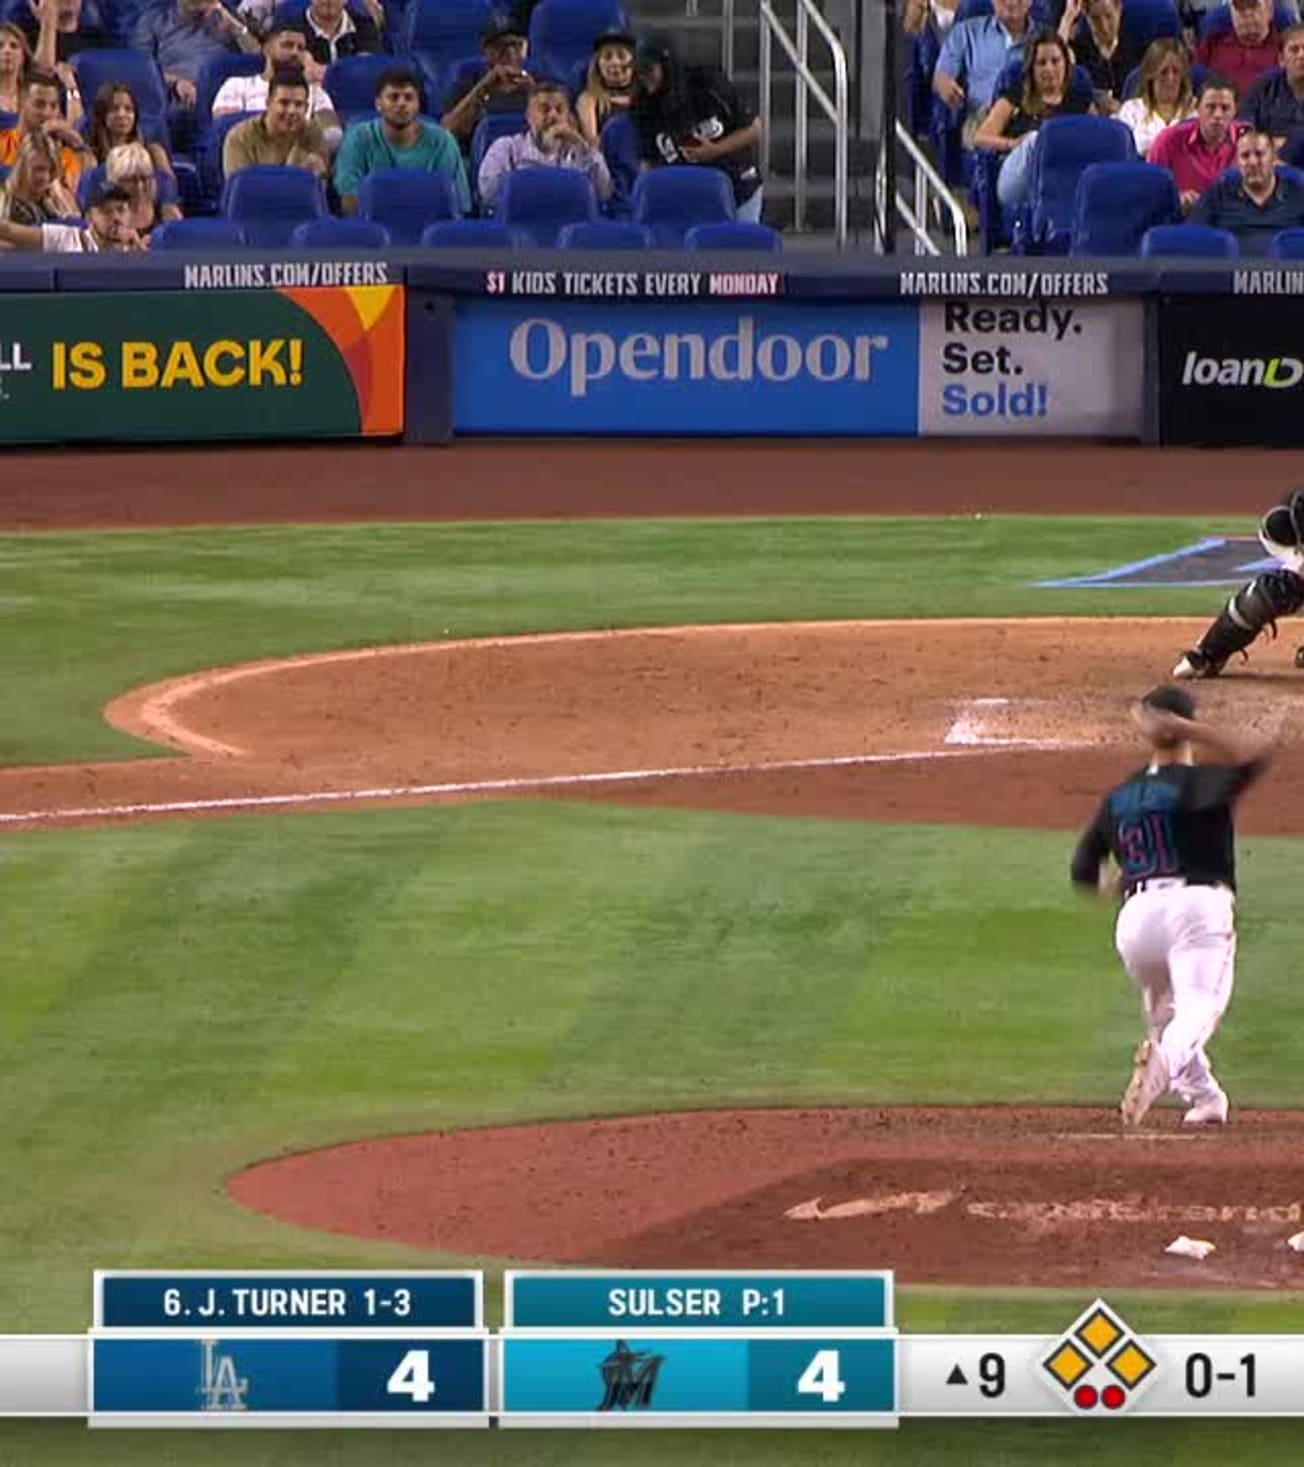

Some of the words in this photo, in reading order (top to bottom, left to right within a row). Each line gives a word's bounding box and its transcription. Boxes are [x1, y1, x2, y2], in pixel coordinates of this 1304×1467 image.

[184, 262, 388, 289] MARLINS.COM/OFFERS
[486, 271, 505, 292] $1
[512, 272, 556, 294] KIDS
[564, 272, 638, 295] TICKETS
[645, 272, 701, 295] EVERY
[709, 273, 779, 294] MONDAY
[900, 272, 1108, 296] MARLINS.COM/OFFERS
[942, 300, 1082, 340] Ready.
[52, 341, 106, 389] IS
[121, 338, 303, 388] BACK!
[509, 316, 888, 397] Opendoor
[942, 342, 1023, 375] Set.
[942, 382, 1048, 417] Sold!
